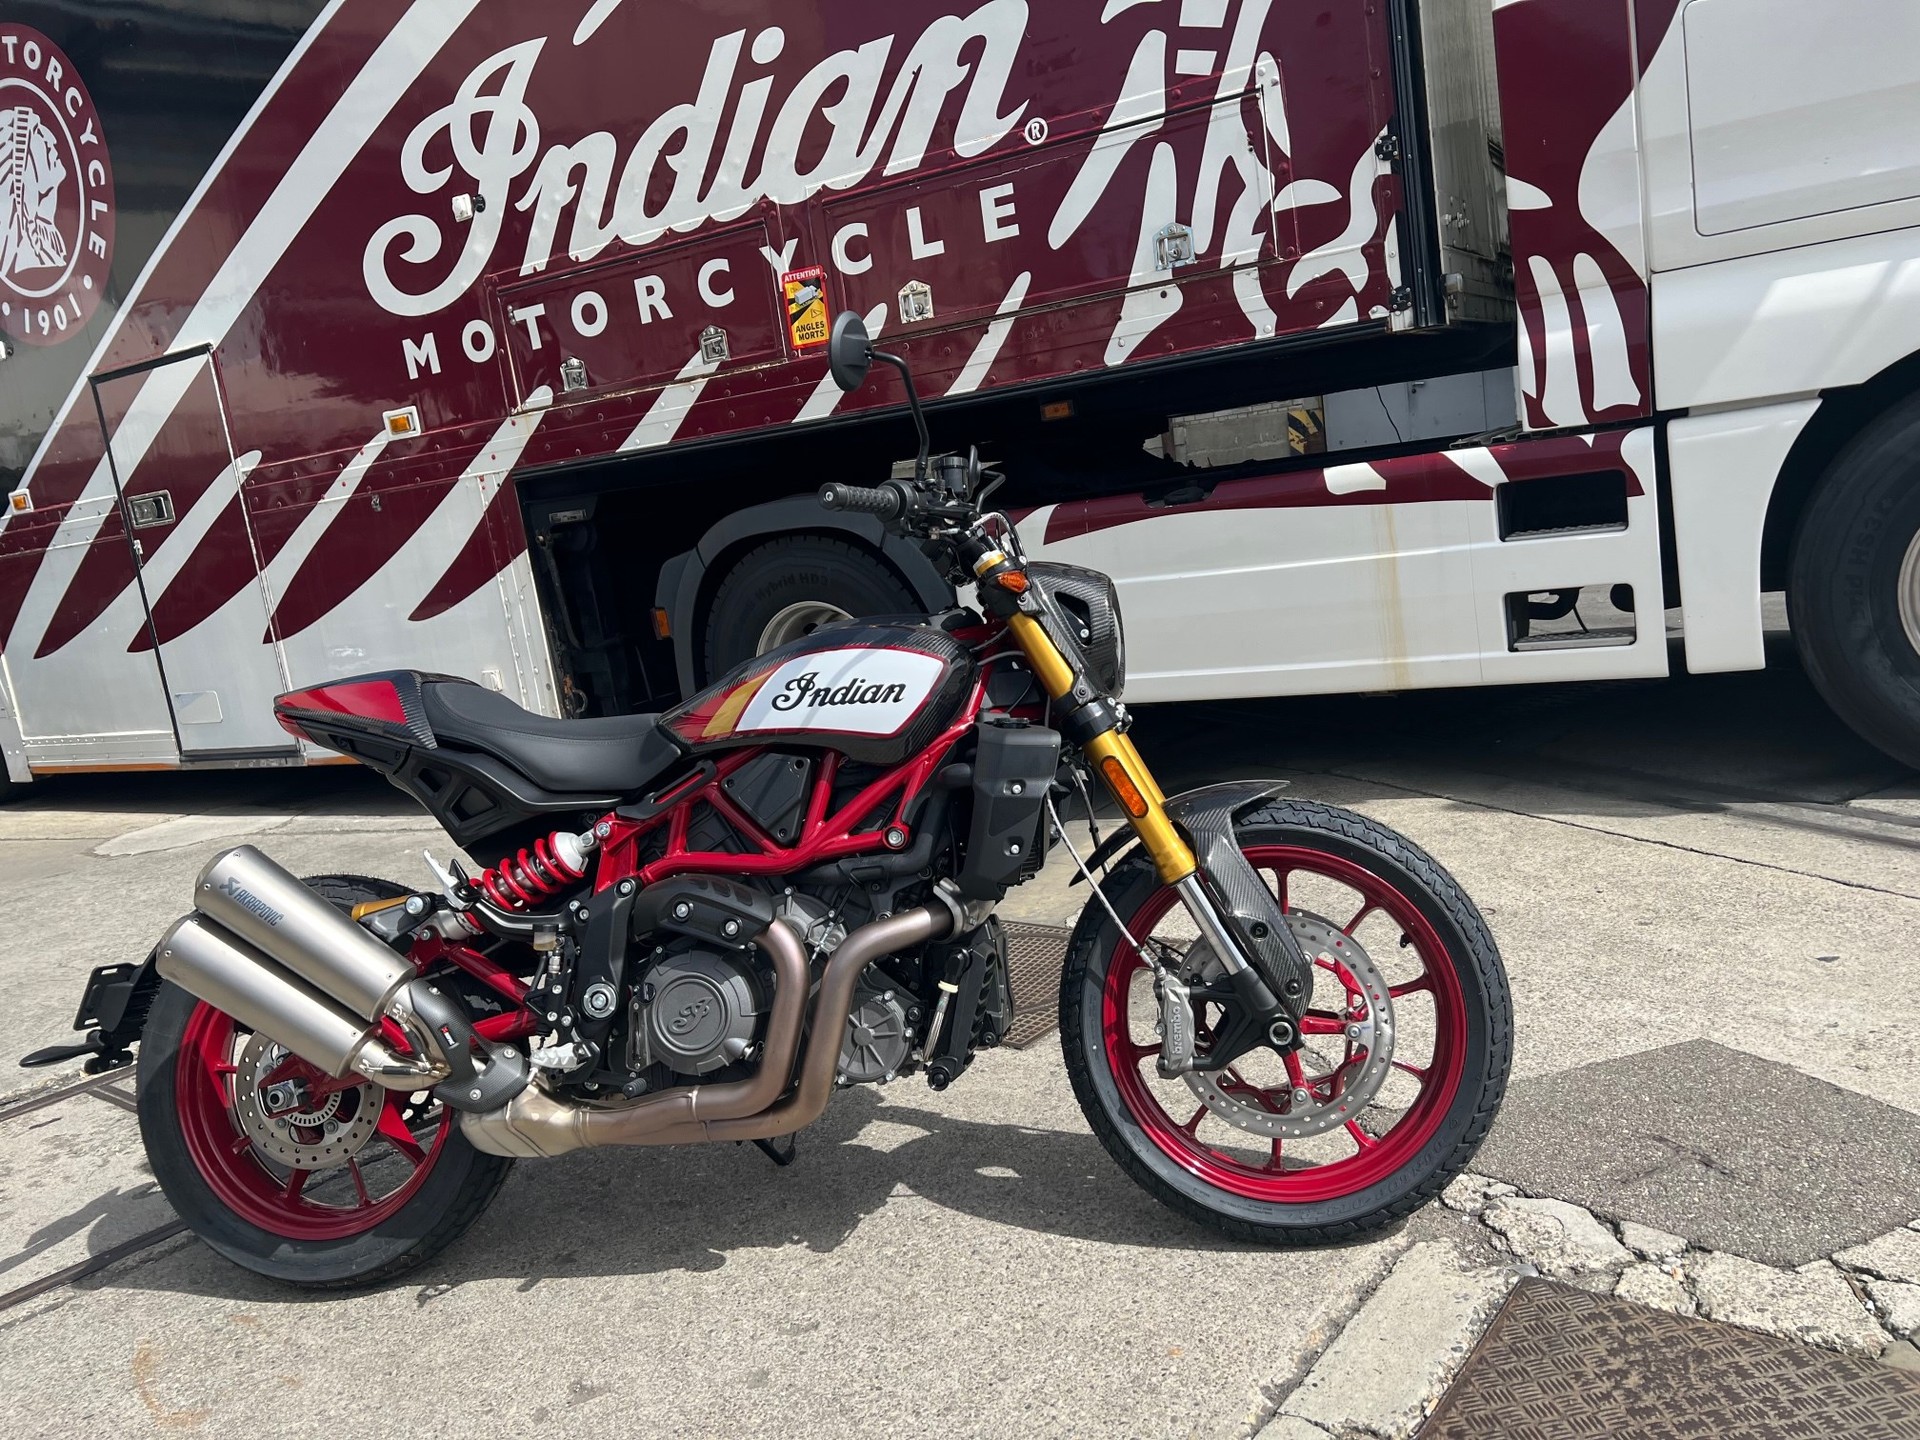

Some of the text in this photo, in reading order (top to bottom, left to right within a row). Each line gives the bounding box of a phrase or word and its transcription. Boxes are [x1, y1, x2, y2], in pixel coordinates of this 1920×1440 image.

[362, 0, 1031, 317] Indian
[402, 183, 1019, 381] MOTORCYCLE
[784, 268, 821, 283] ATTENTION
[795, 320, 825, 333] ANGLES
[798, 329, 825, 342] MORTS
[771, 671, 907, 711] Indian
[1170, 1006, 1182, 1055] brembo
